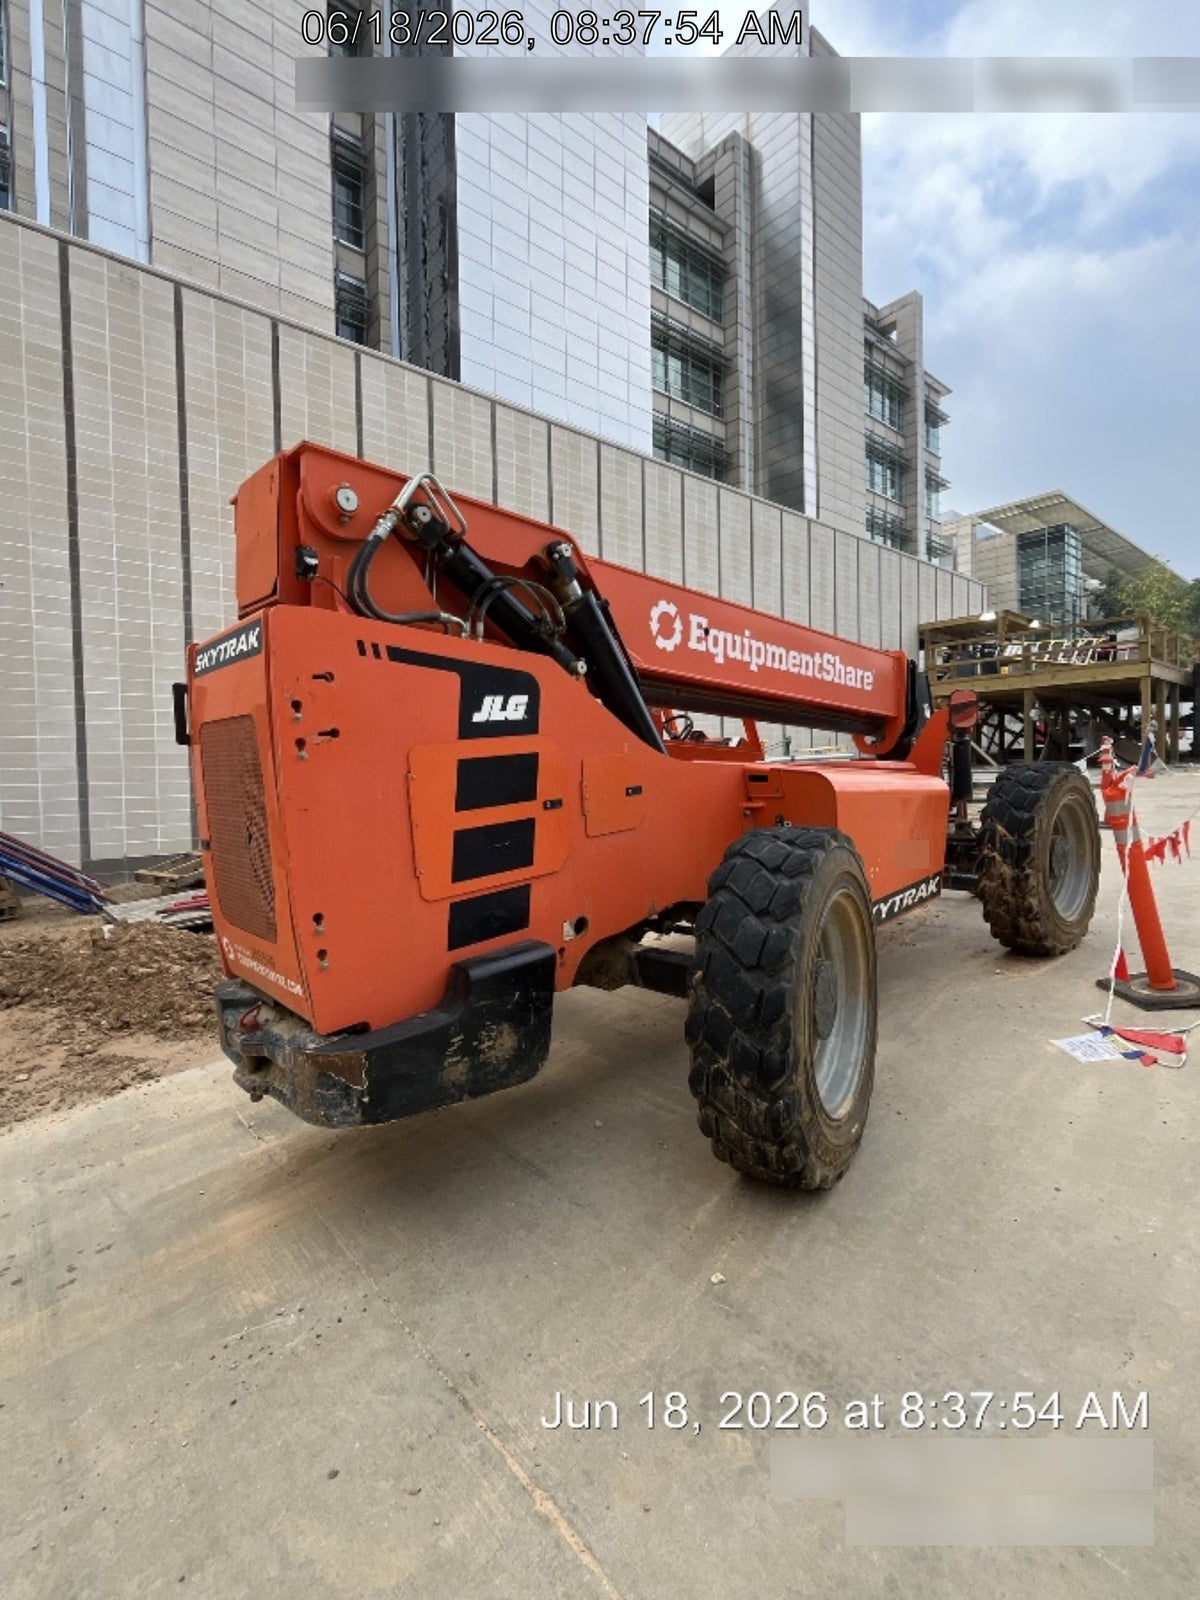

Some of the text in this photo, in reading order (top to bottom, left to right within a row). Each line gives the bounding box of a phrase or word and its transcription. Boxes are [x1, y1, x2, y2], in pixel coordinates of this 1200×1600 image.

[195, 627, 260, 673] SKYTRAK
[688, 613, 874, 691] EquipmentShare
[472, 694, 528, 722] JLG
[873, 876, 940, 918] YTRAK
